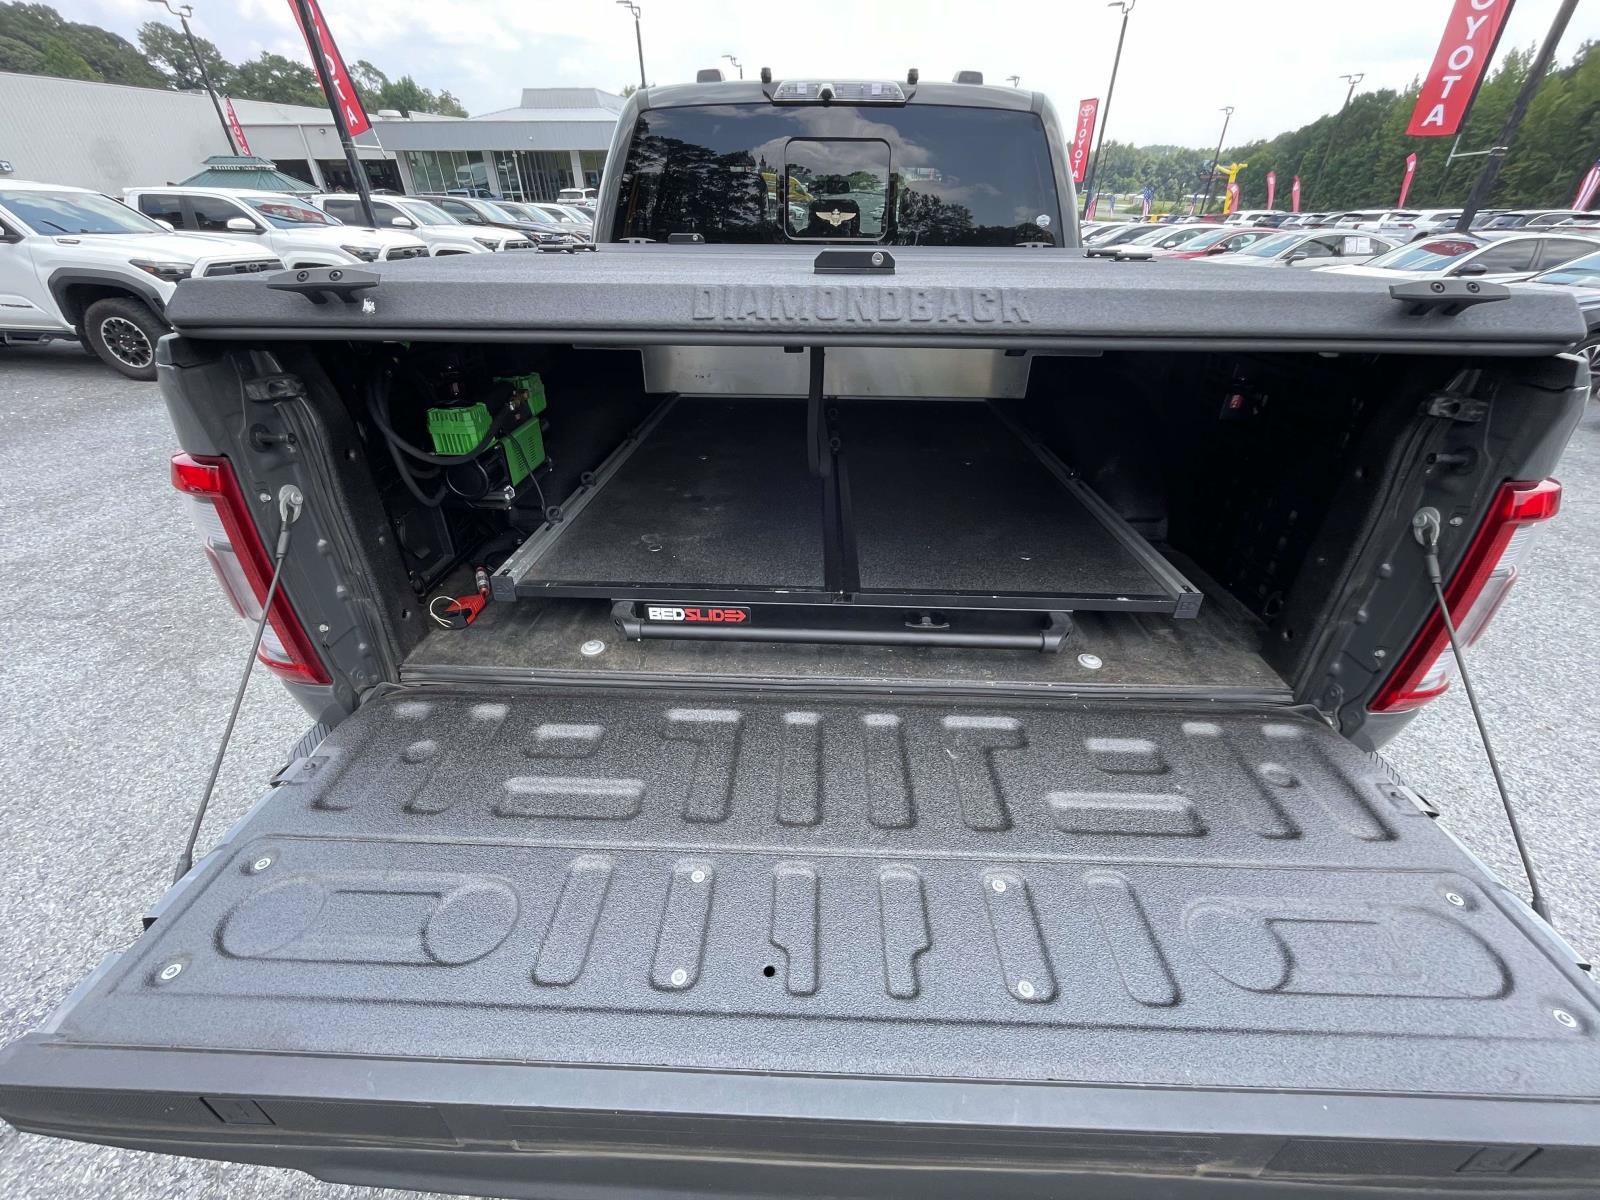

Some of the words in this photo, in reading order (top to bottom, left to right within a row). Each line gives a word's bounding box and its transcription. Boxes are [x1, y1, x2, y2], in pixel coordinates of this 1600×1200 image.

[1072, 118, 1089, 179] TOYOTA
[692, 286, 1031, 323] DIAMONDBACK
[648, 607, 746, 622] BEDSLIDE
